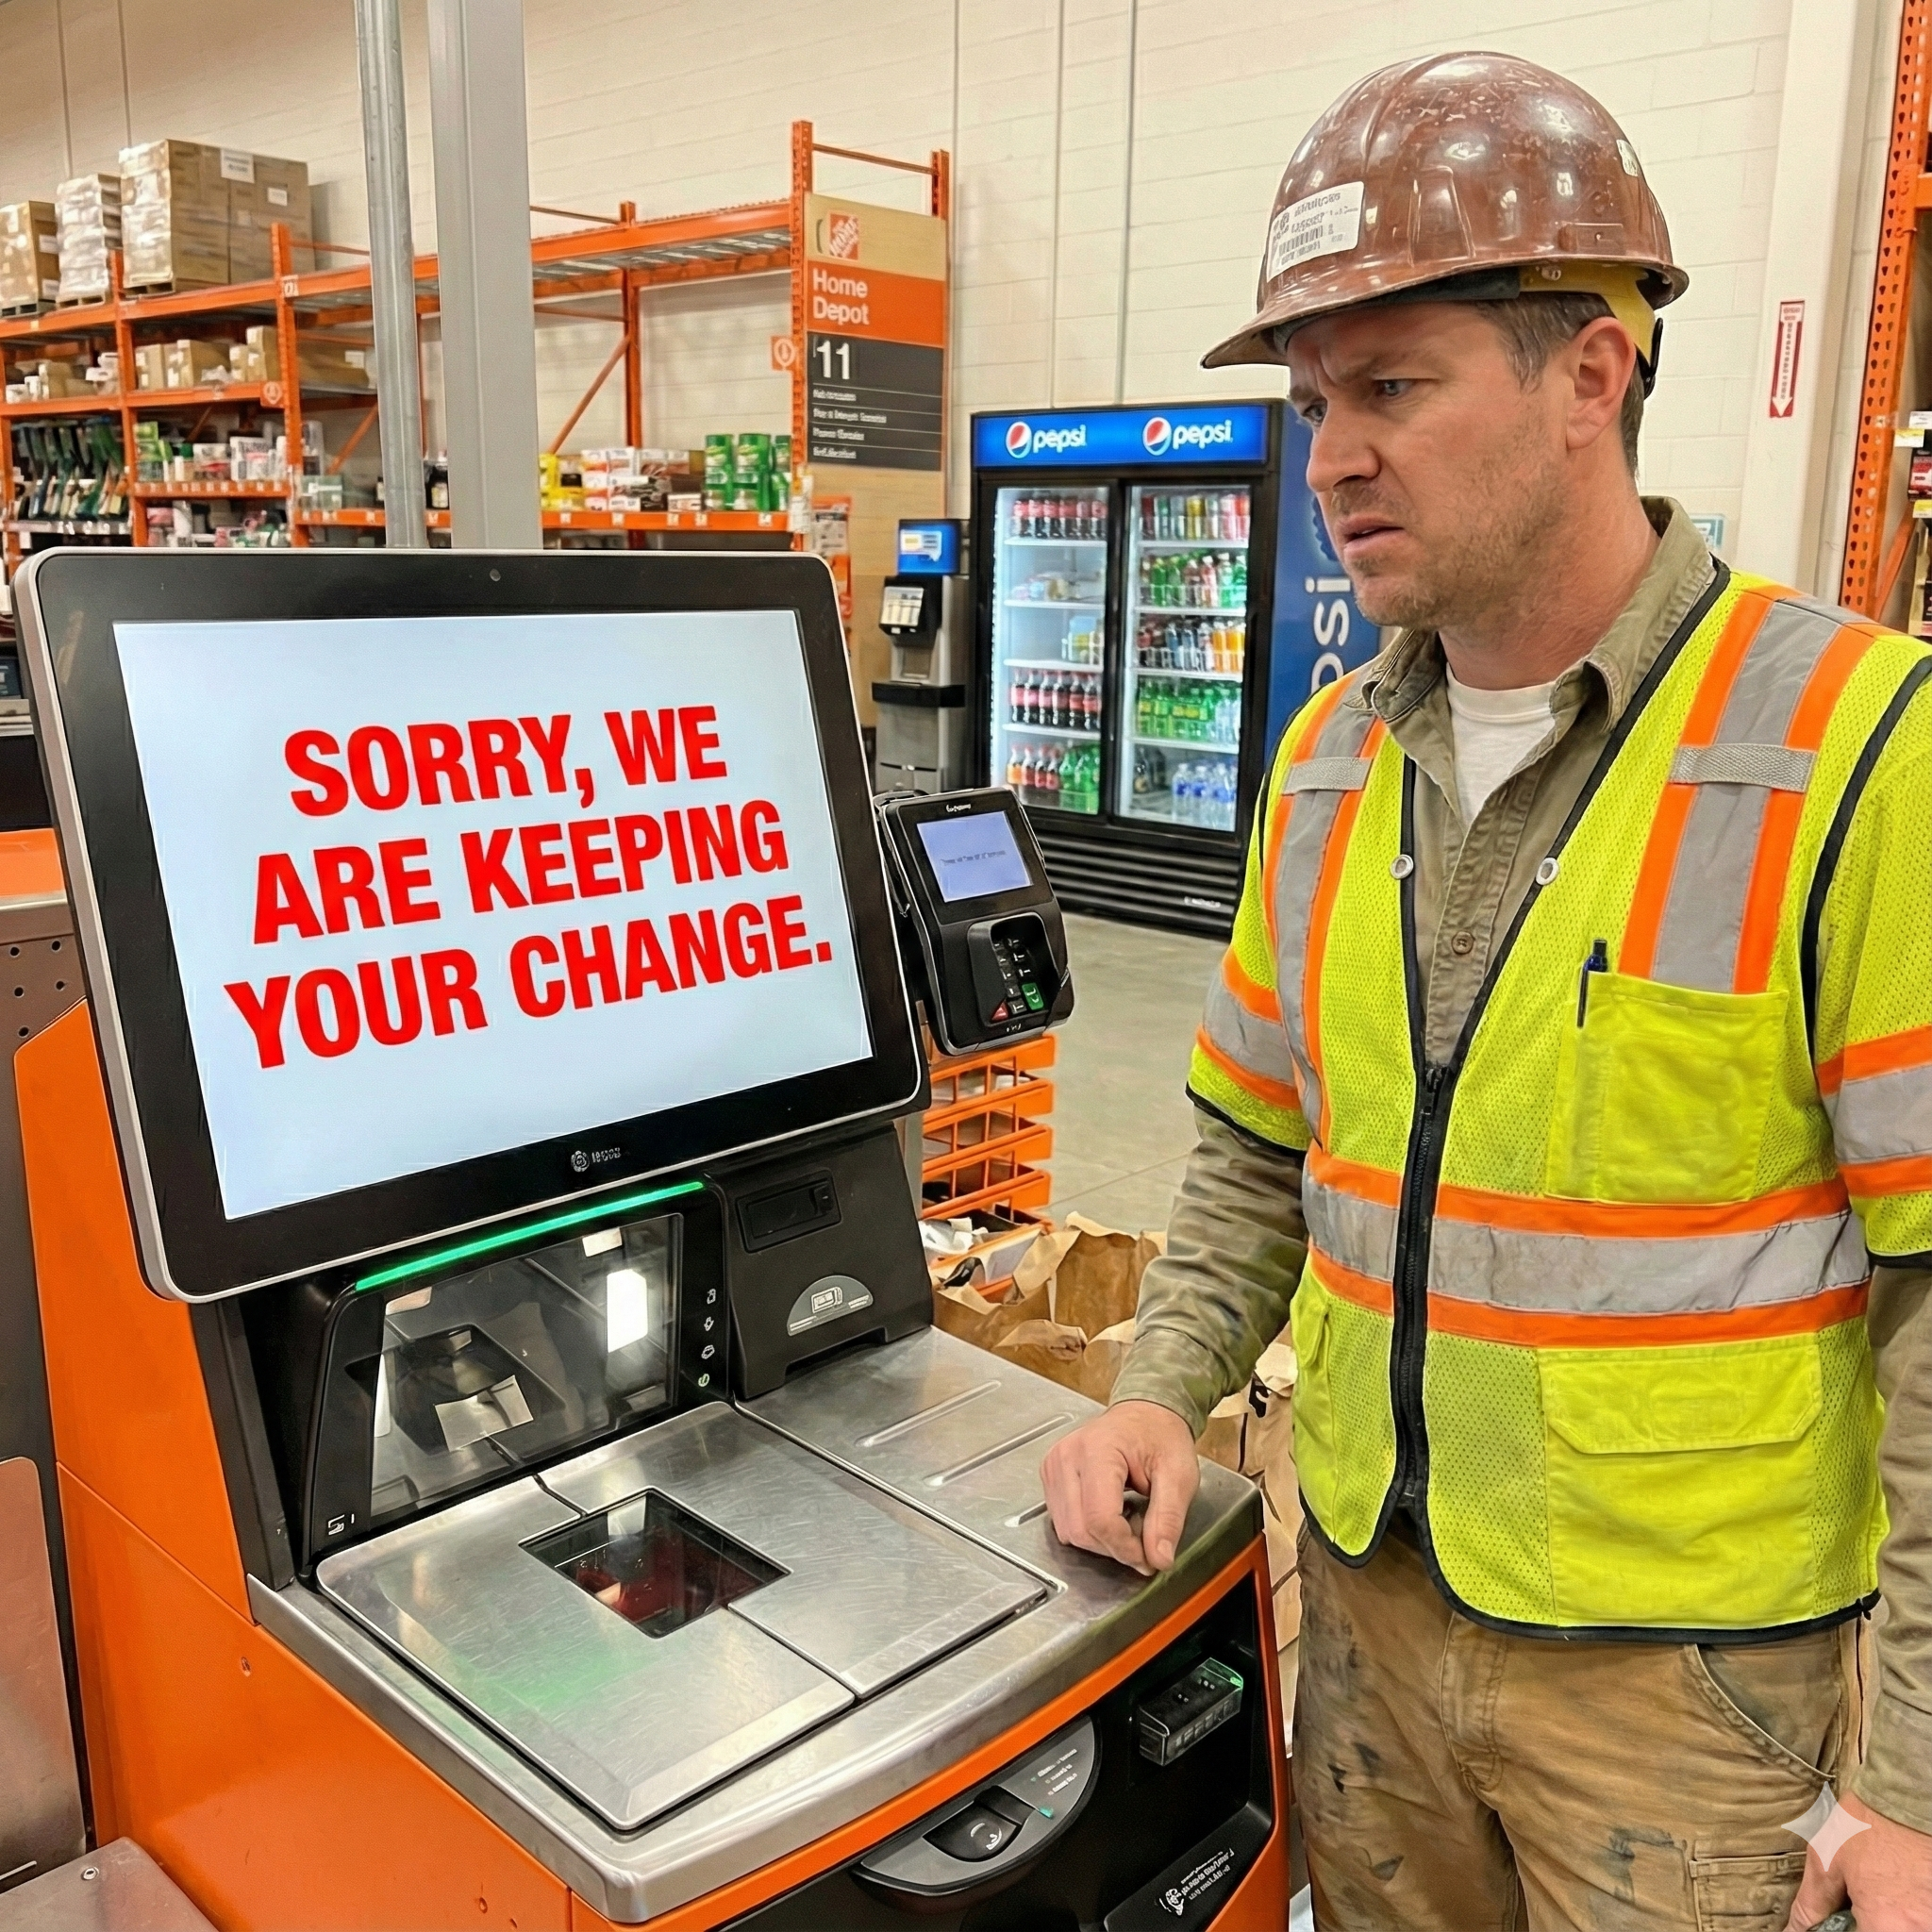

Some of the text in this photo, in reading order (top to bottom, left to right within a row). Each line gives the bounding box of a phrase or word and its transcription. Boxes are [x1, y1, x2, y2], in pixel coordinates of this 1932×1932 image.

[812, 268, 868, 299] Home
[812, 295, 870, 325] Depot
[816, 340, 850, 380] 11
[1033, 425, 1087, 453] pepsi
[1173, 420, 1233, 450] pepsi
[283, 705, 727, 818] SORRY, WE
[253, 800, 789, 945] ARE KEEPING
[223, 894, 832, 1069] YOUR CHANGE.
